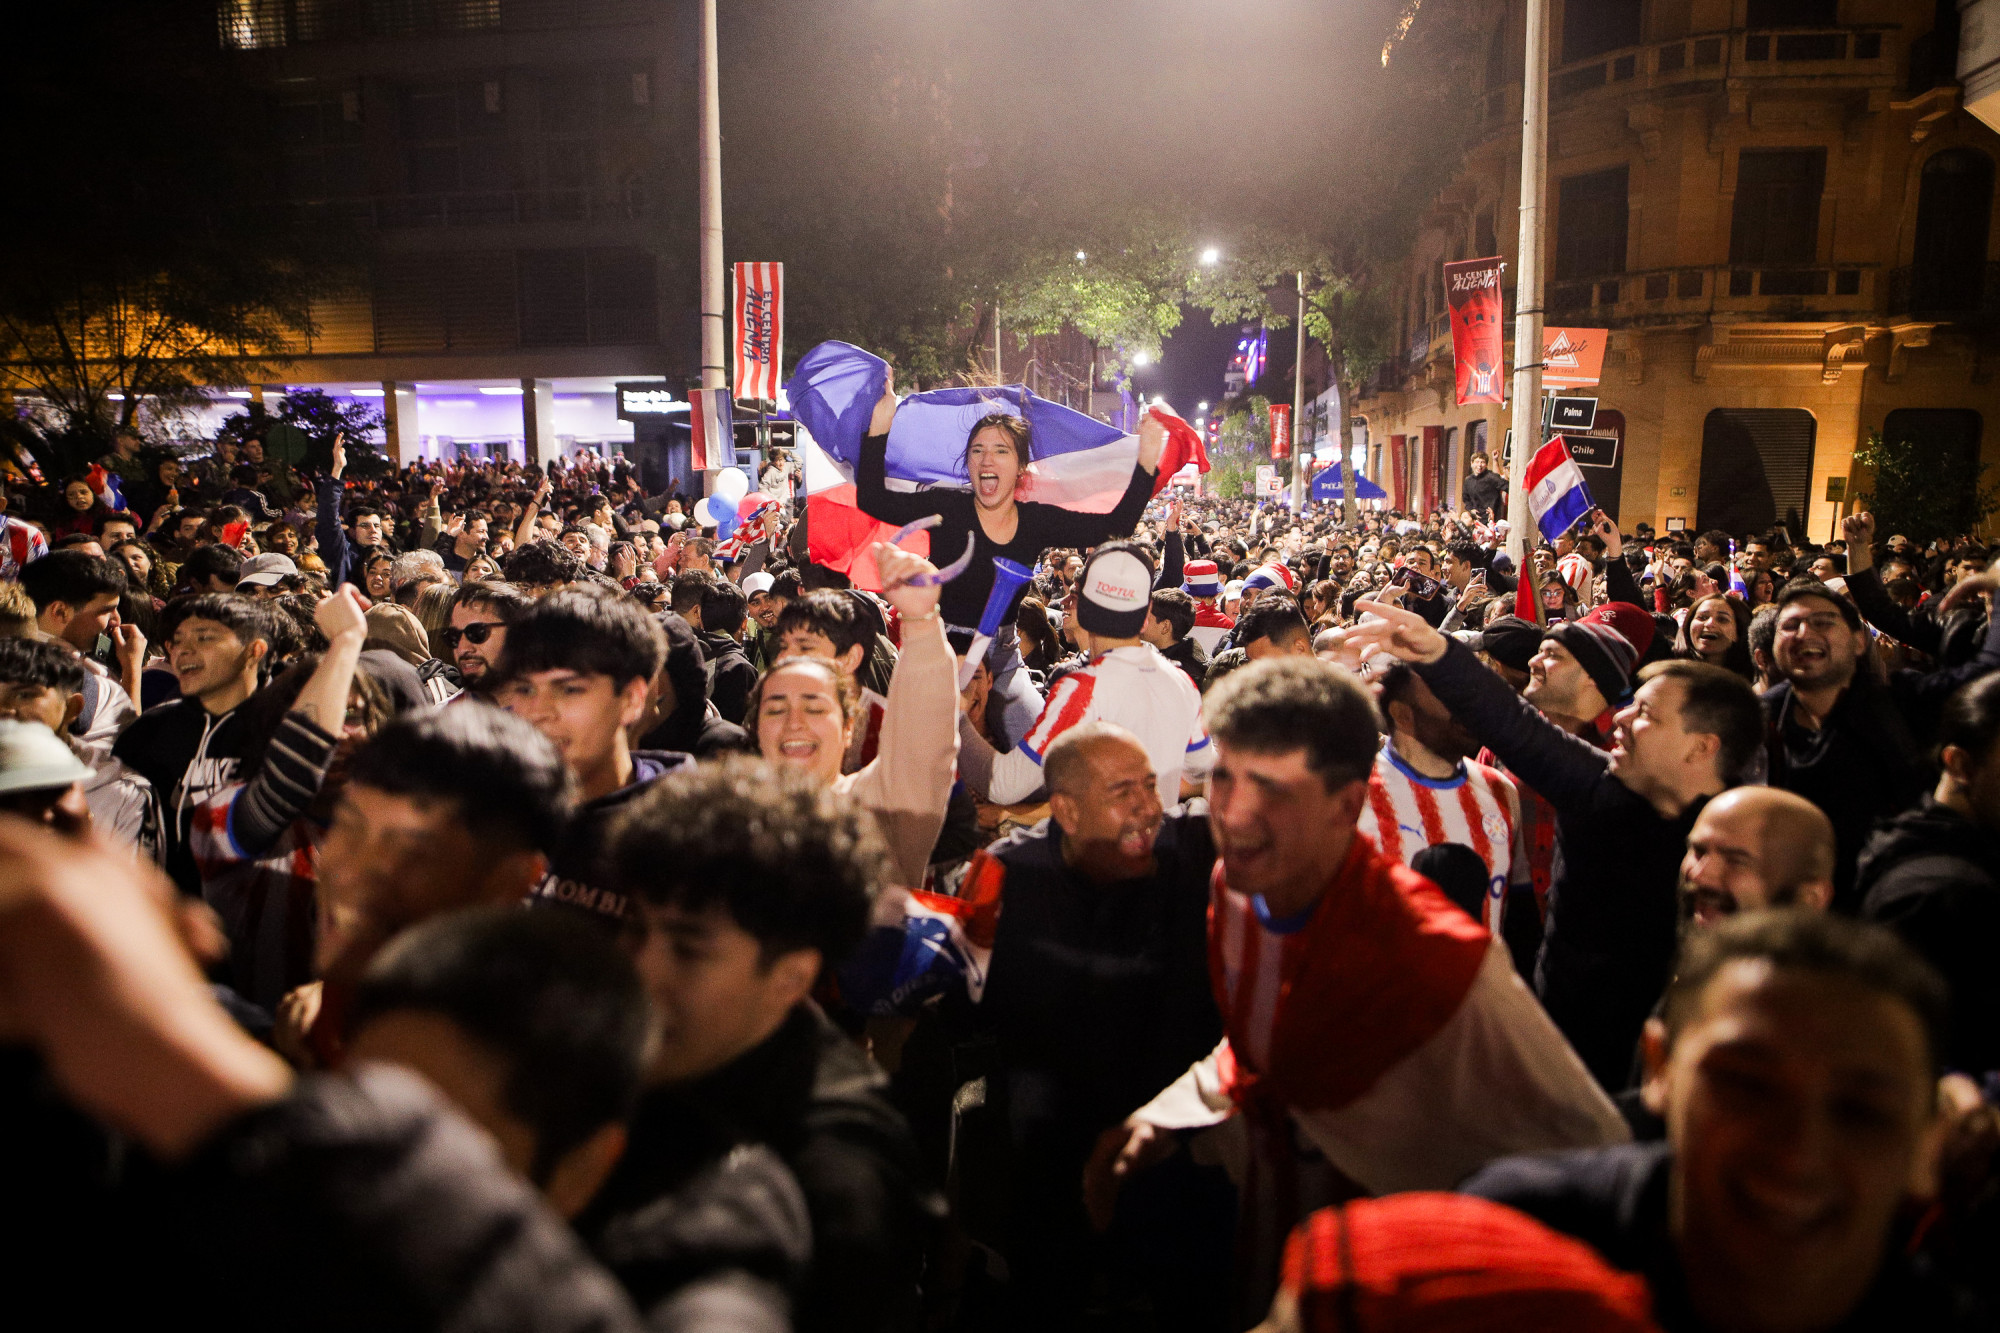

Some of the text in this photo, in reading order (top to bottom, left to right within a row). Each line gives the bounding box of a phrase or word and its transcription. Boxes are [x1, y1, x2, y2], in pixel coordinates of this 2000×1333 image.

[1453, 269, 1498, 281] EL CENTRO
[760, 291, 773, 364] EL CENTRO
[1563, 407, 1583, 417] Palma
[1571, 445, 1595, 455] Chile
[1096, 581, 1136, 598] TOPTUL
